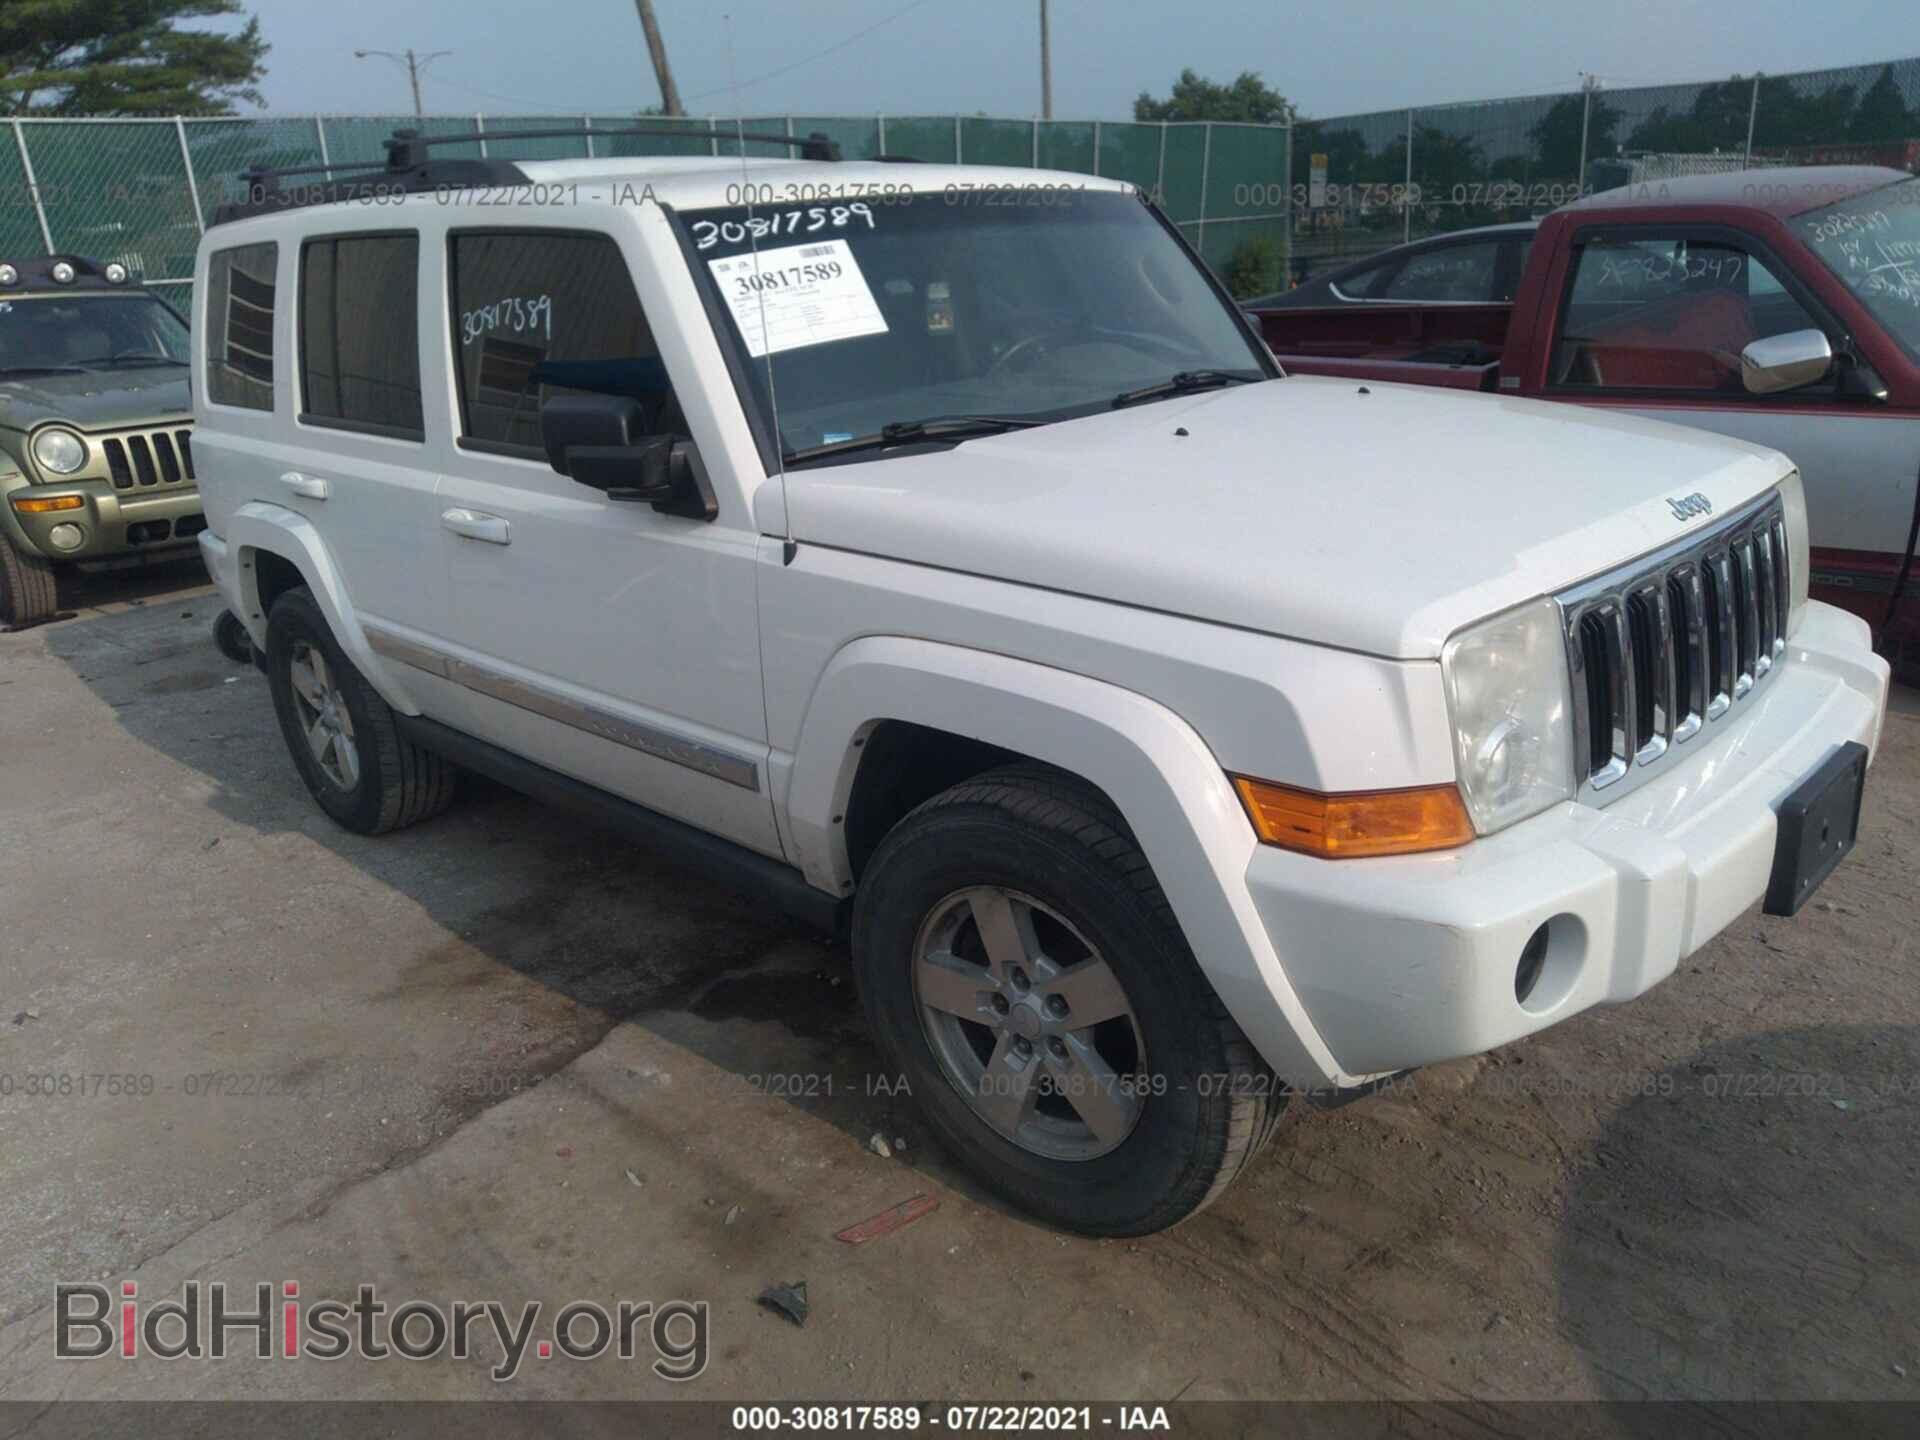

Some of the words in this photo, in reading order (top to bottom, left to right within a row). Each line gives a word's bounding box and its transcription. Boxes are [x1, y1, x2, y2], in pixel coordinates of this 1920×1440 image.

[693, 202, 875, 250] 30817589
[735, 259, 844, 296] 30817589
[463, 294, 552, 345] 30817589
